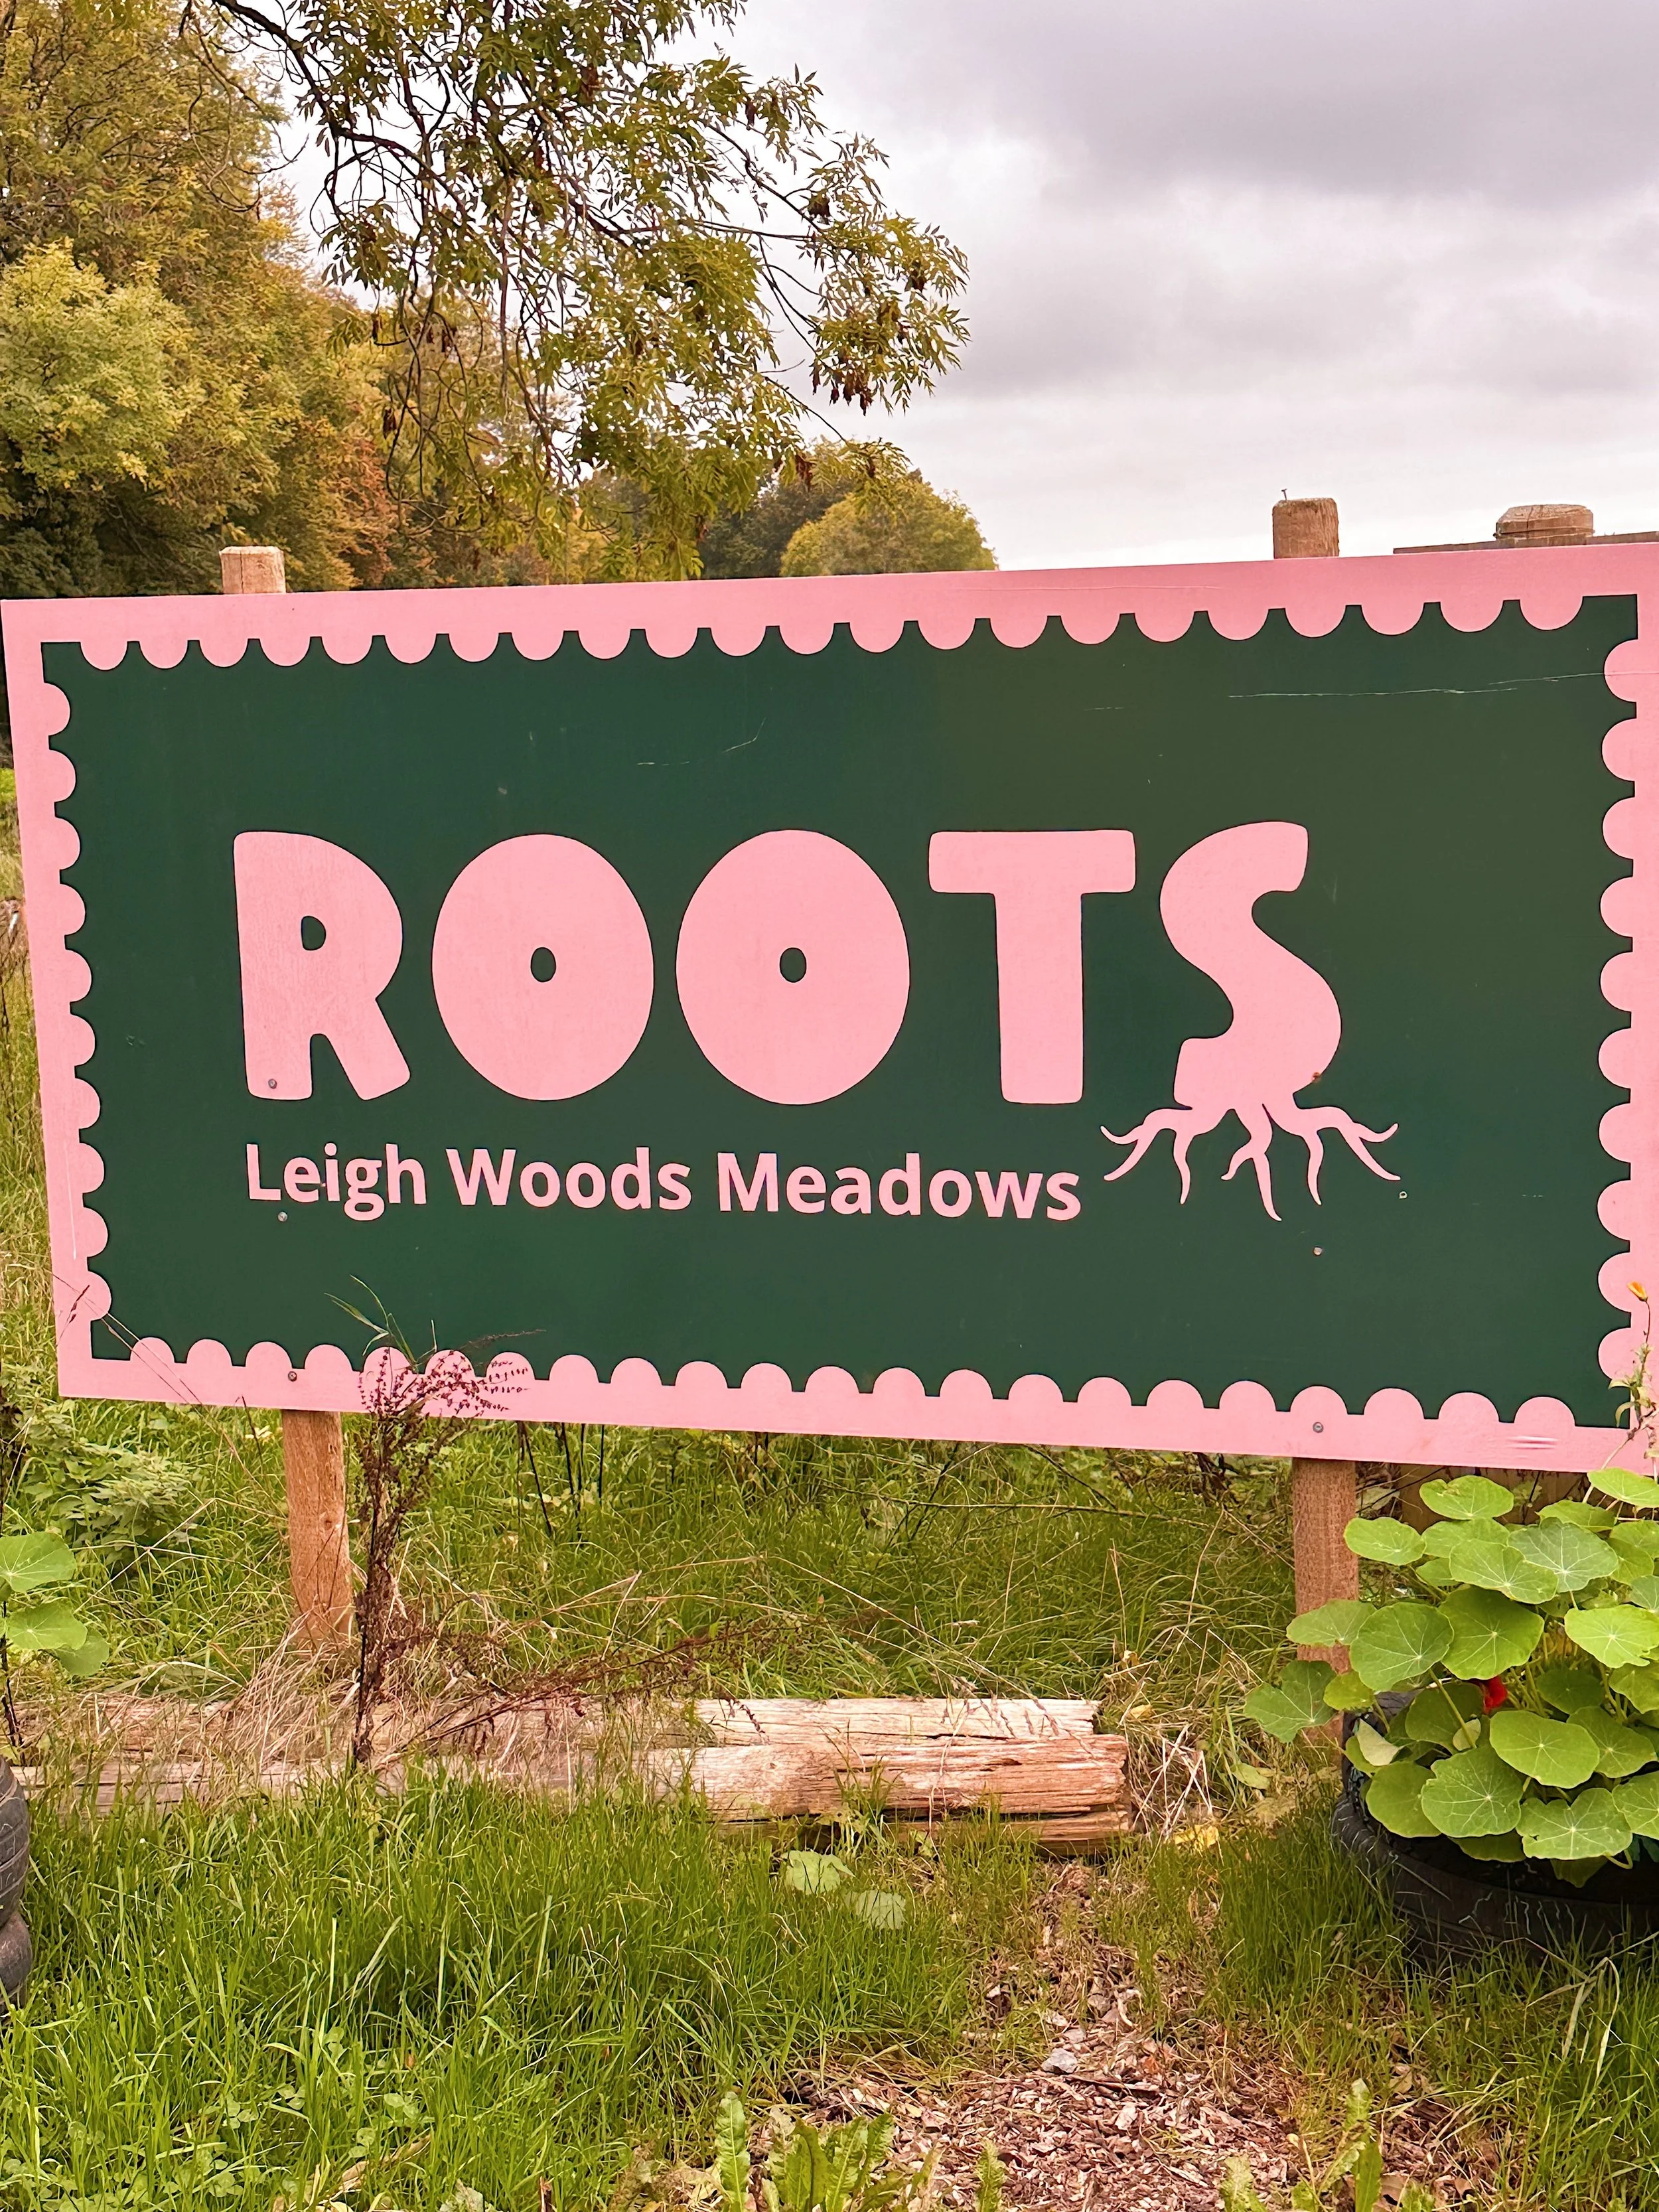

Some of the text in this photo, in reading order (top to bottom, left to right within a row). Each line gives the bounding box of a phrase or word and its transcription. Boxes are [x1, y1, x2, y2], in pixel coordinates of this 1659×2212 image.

[234, 822, 1342, 1107] ROOTS
[246, 1142, 1082, 1222] Leigh Woods Meadows
